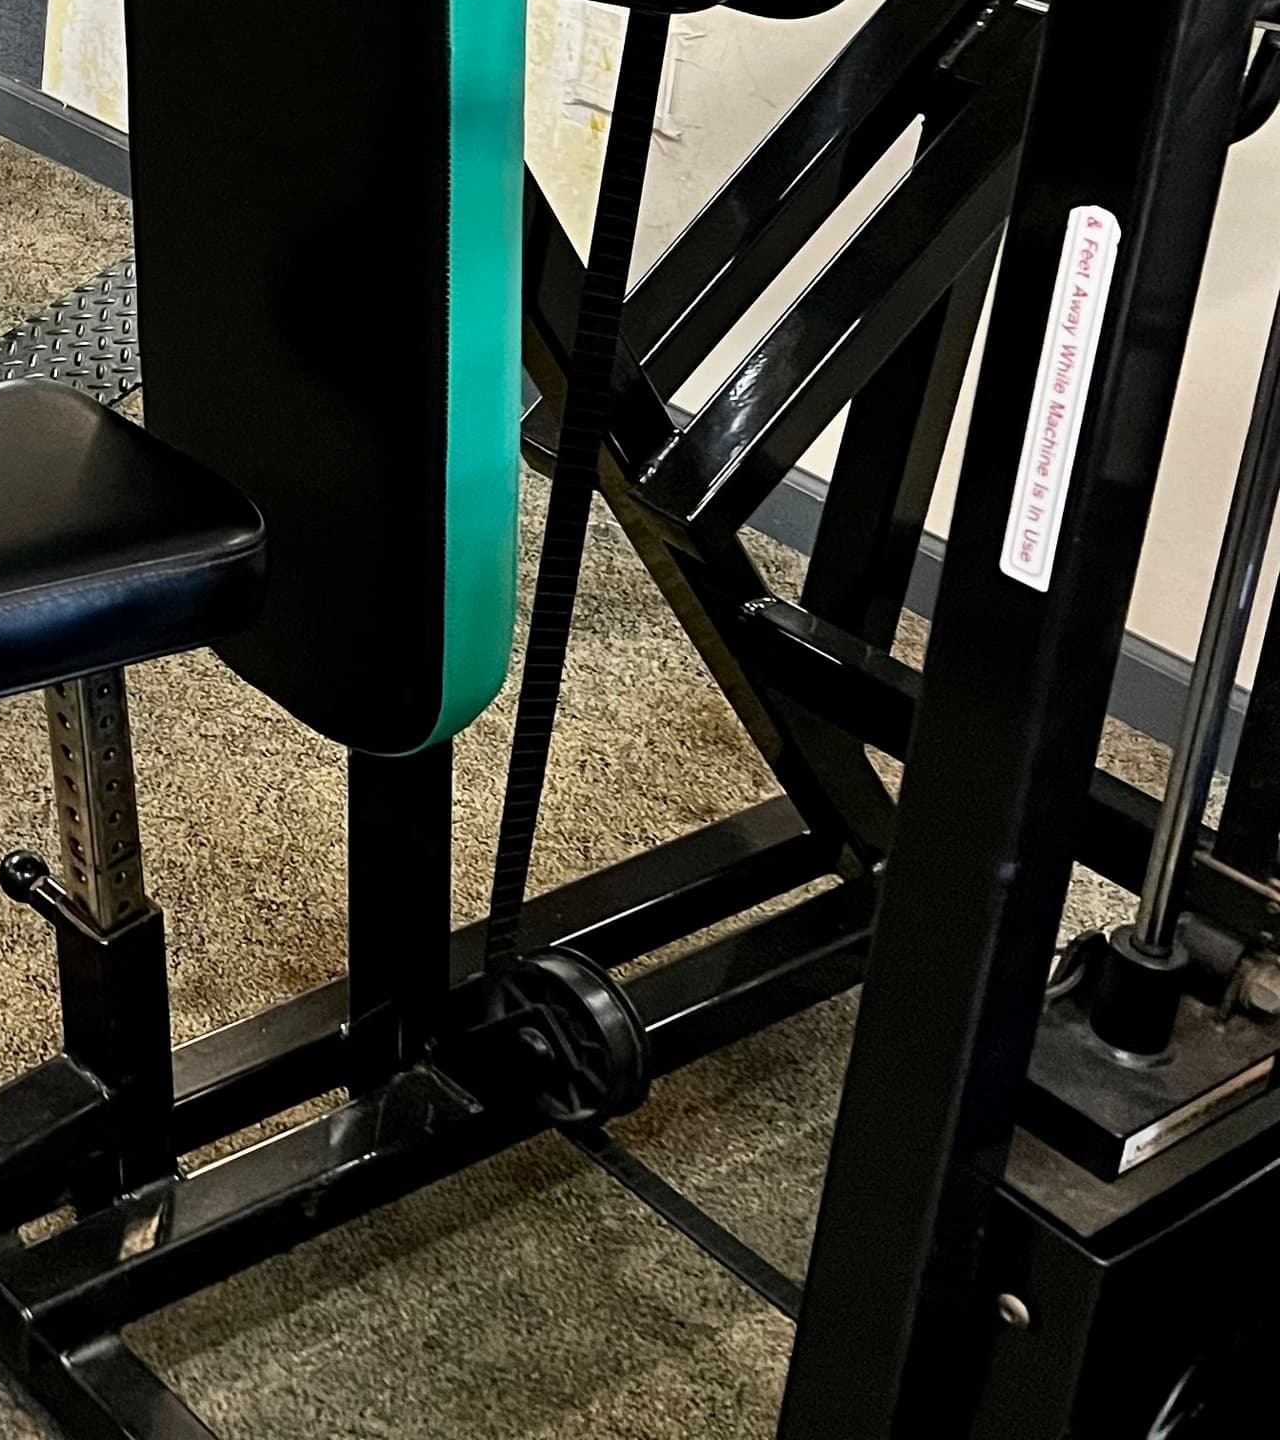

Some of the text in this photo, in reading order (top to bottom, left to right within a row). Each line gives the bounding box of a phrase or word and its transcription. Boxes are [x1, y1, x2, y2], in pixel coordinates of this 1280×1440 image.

[1087, 216, 1103, 228] &
[1062, 285, 1088, 336] Away
[1054, 344, 1077, 394] While
[1037, 400, 1065, 476] Machine
[1032, 483, 1048, 499] Is
[1027, 505, 1045, 522] In
[1020, 529, 1040, 562] Use
